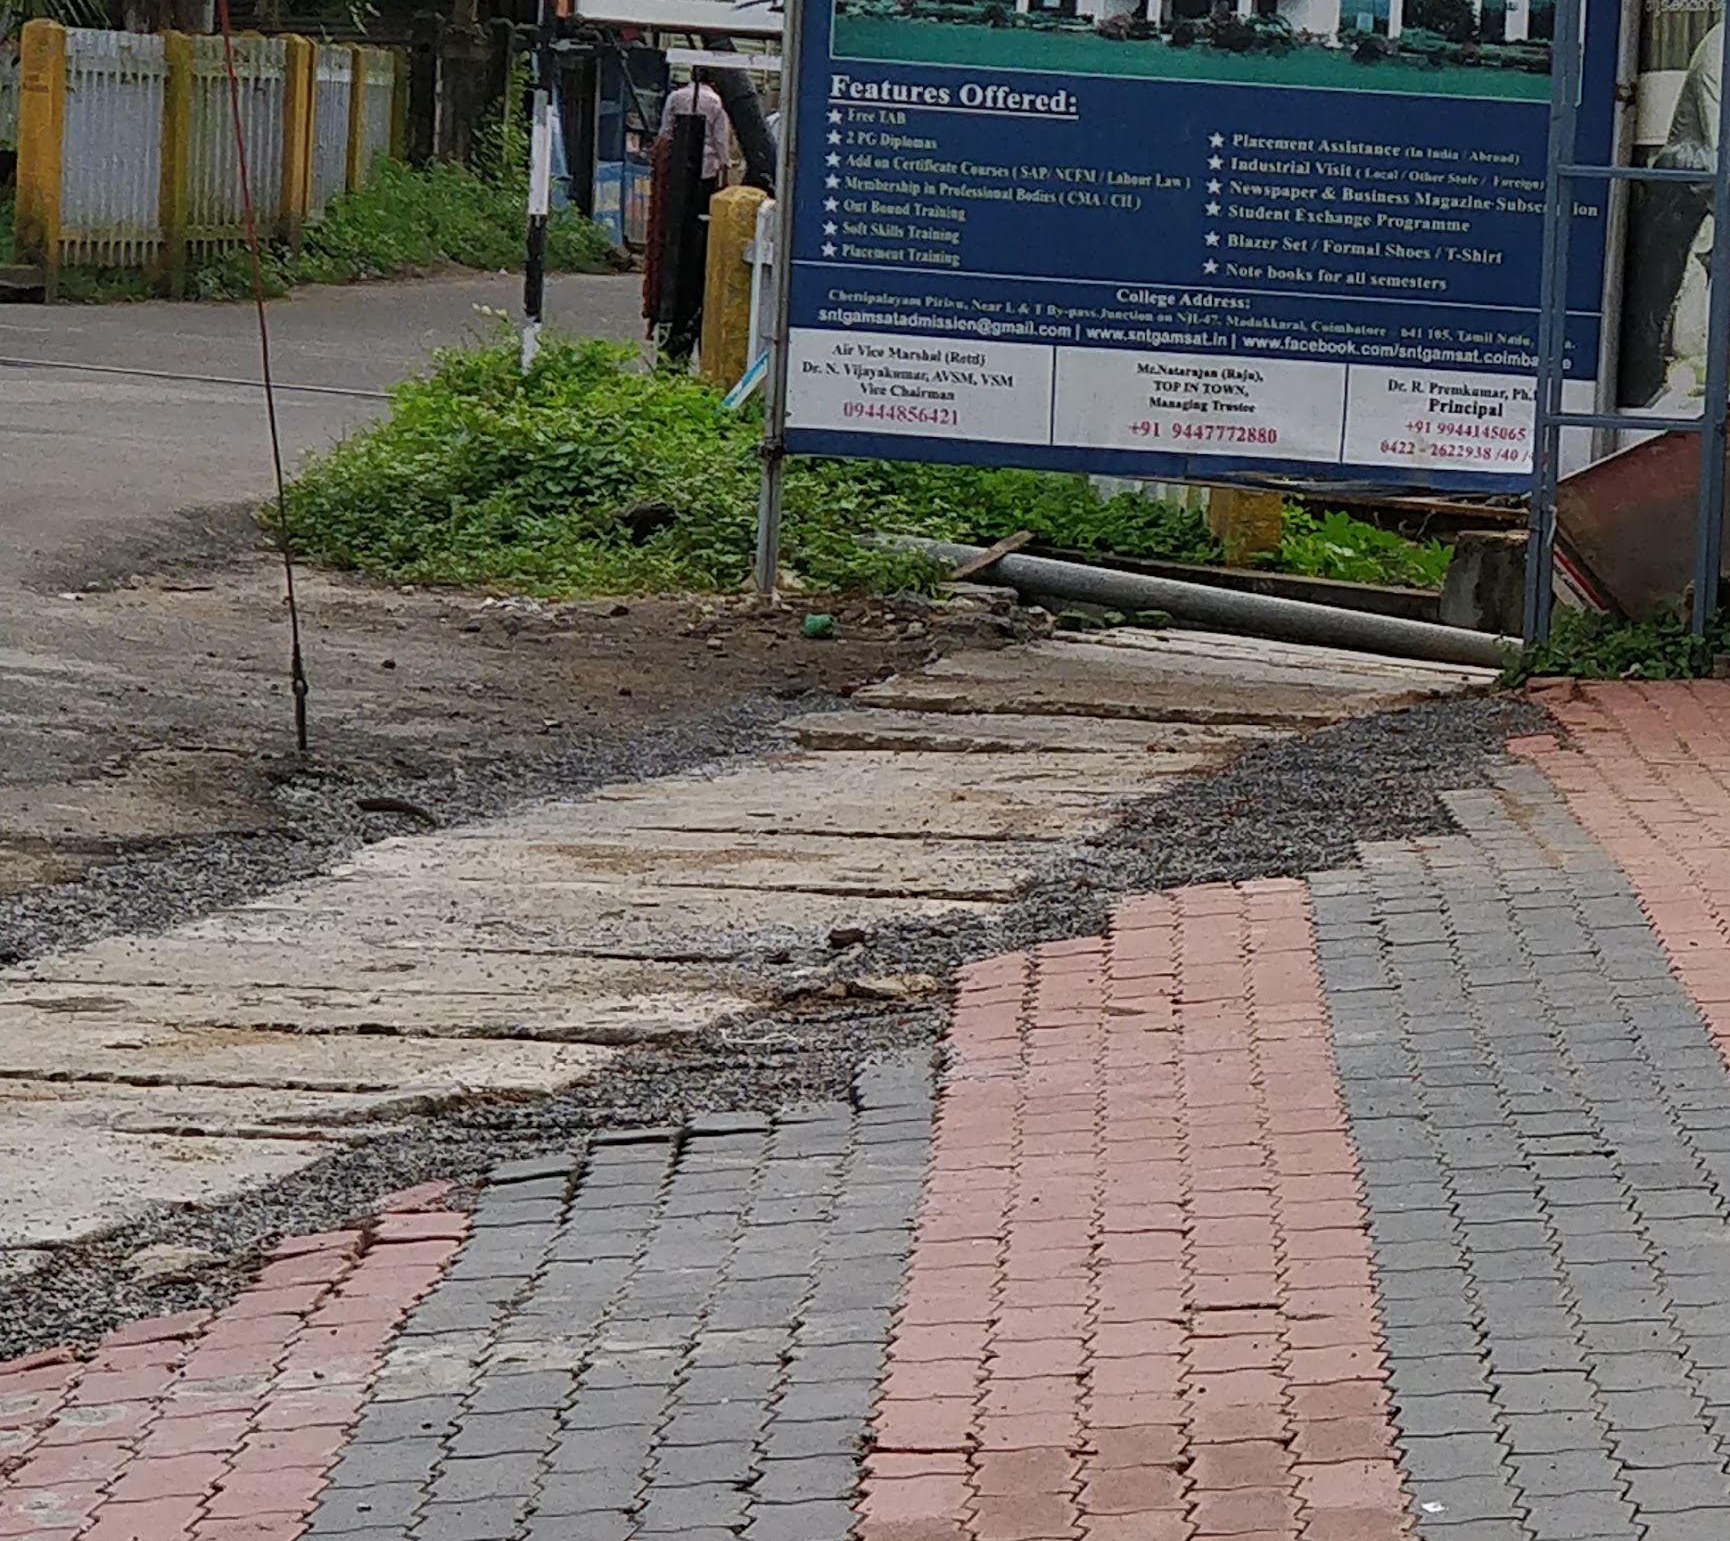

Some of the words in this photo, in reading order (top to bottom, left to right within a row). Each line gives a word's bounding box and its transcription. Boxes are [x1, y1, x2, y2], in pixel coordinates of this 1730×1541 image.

[829, 74, 951, 104] Features
[959, 84, 1078, 113] Offered:
[1232, 133, 1315, 153] Placement
[1318, 139, 1401, 158] Assistance
[846, 154, 872, 169] Add
[1231, 157, 1311, 175] Industrial
[1316, 161, 1353, 179] Visit
[845, 175, 921, 197] Membership
[1229, 179, 1318, 202] Newspaper
[1321, 185, 1337, 201] &
[1342, 188, 1410, 206] Business
[914, 203, 966, 222] Training
[1228, 203, 1290, 223] Student
[1295, 208, 1372, 228] Exchange
[1376, 213, 1471, 233] Programme
[842, 221, 868, 237] Soft
[907, 225, 960, 245] Training
[841, 243, 904, 262] Placement
[907, 246, 961, 267] Training
[1226, 233, 1279, 252] Blazer
[1282, 236, 1308, 252] Set
[1322, 239, 1381, 257] Formal
[1384, 245, 1431, 259] Shoes
[1445, 247, 1503, 265] T-Shirt
[1226, 262, 1263, 279] Note
[1267, 265, 1313, 283] books
[1317, 268, 1343, 284] for
[1346, 271, 1367, 285] all
[1369, 274, 1448, 291] semesters
[1115, 288, 1177, 310] College
[1179, 293, 1252, 310] Address:
[817, 308, 1072, 338] sntgamsatadmission@gmail.com
[1085, 325, 1228, 349] www.sntgamsat.in
[831, 343, 855, 358] Air
[858, 344, 885, 359] Vice
[889, 346, 942, 364] Marshal
[801, 360, 823, 375] Dr.
[981, 371, 1015, 388] VSM
[1387, 378, 1408, 393] Dr.
[859, 382, 887, 397] Vice
[890, 384, 955, 402] Chairman
[1153, 380, 1182, 394] TOP
[1183, 383, 1200, 395] IN
[843, 401, 959, 426] 09444856421
[1149, 395, 1208, 415] Managing
[1211, 401, 1256, 415] Trustee
[1428, 397, 1504, 420] Principal
[1127, 422, 1161, 438] +91
[1171, 423, 1278, 445] 9447772880
